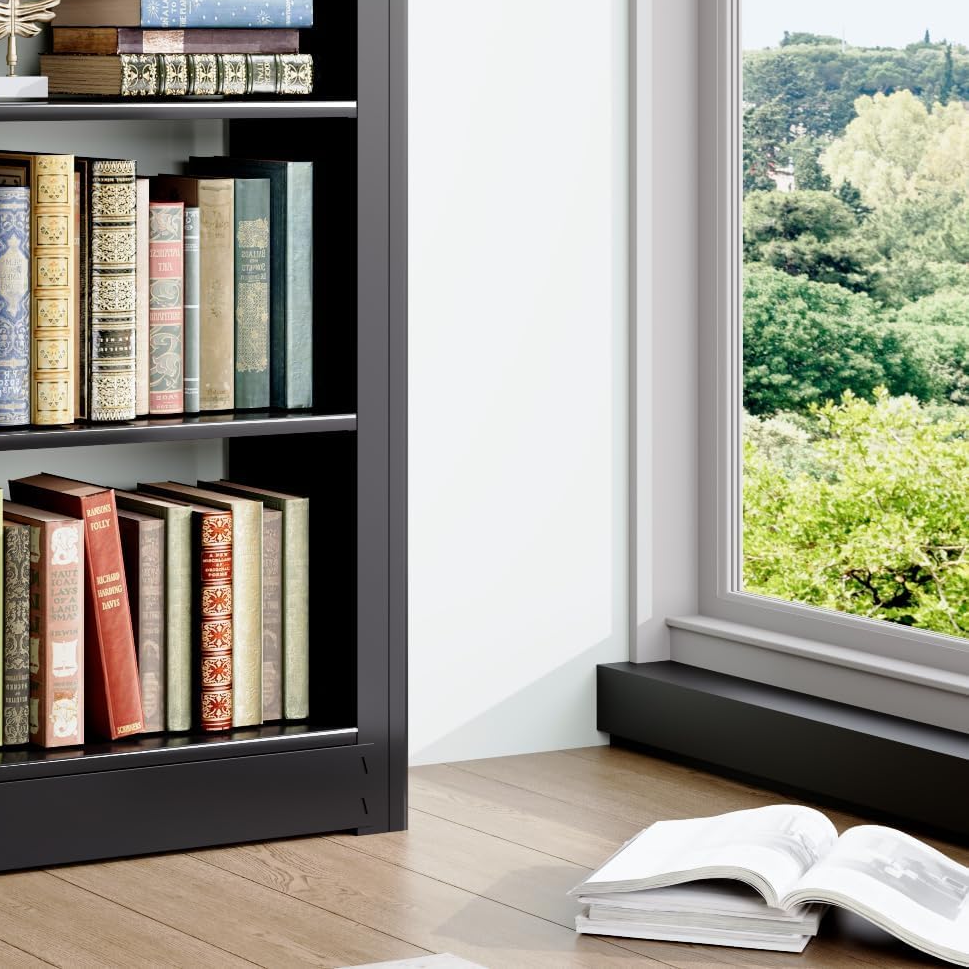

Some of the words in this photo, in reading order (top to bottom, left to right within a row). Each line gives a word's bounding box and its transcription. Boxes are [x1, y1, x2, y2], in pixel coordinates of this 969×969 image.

[90, 518, 111, 531] FOLLY
[96, 572, 120, 585] RICHARD
[97, 584, 123, 598] HARDING
[101, 598, 120, 610] DAVIS
